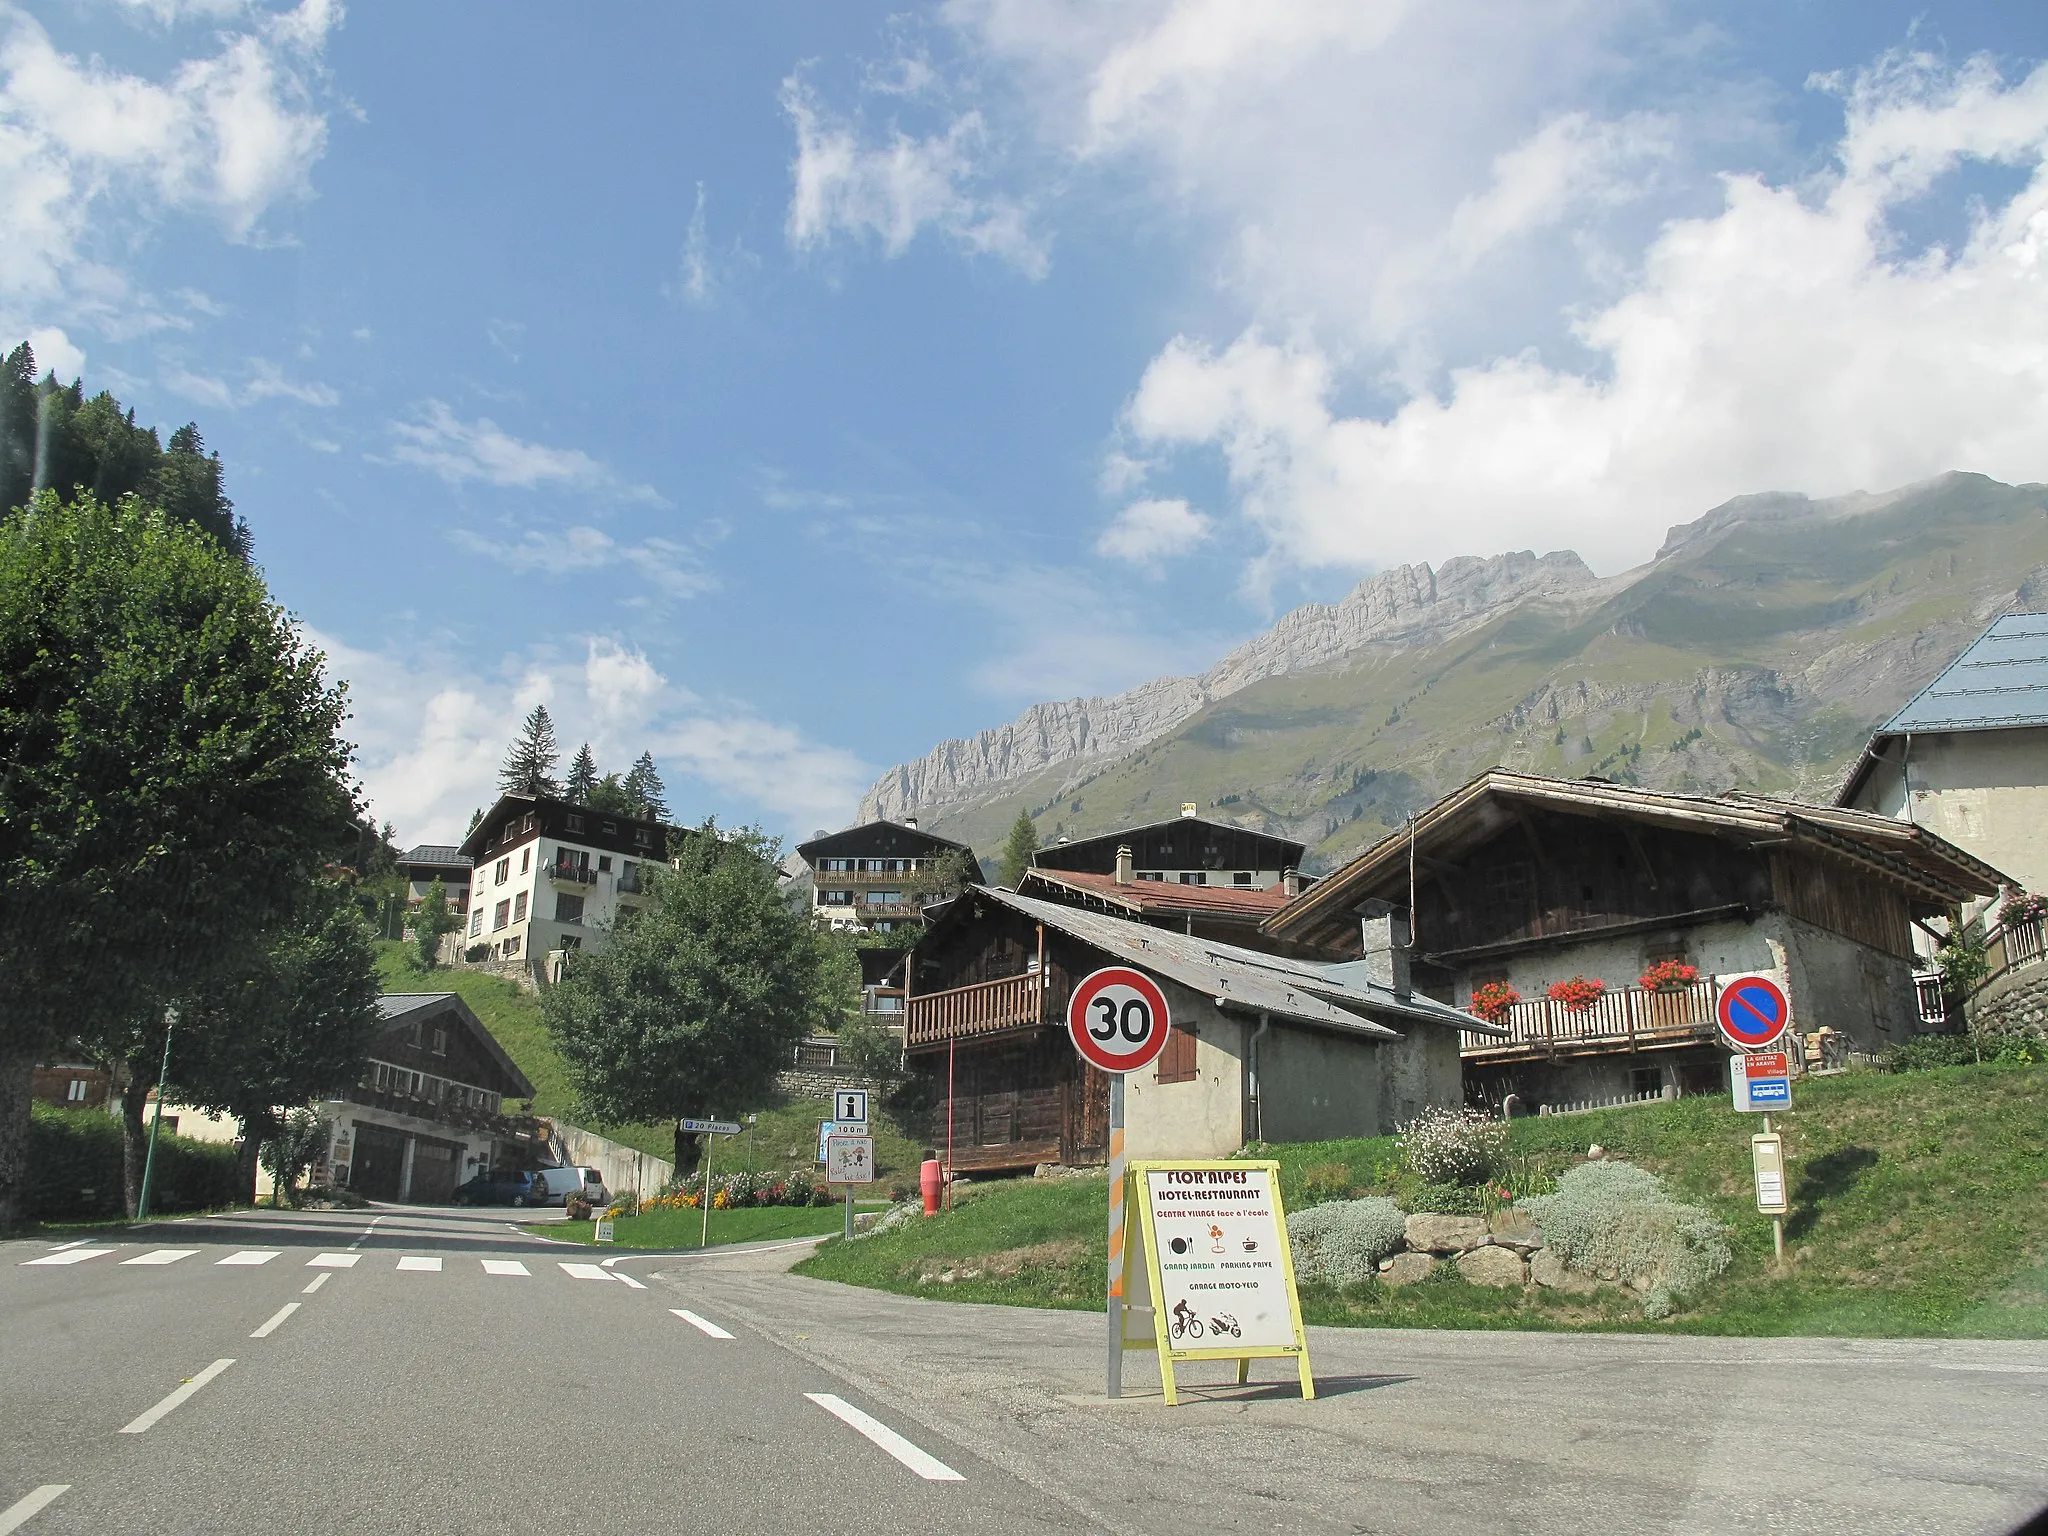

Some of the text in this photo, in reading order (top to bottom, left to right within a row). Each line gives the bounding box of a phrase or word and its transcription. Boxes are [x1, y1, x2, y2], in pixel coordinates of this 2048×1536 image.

[1089, 996, 1150, 1043] 30
[707, 1123, 730, 1132] Places
[1167, 1171, 1247, 1184] FLOR'ALPES
[1158, 1189, 1260, 1200] HOTEL-RESTAURANT
[1157, 1210, 1186, 1218] CENTRE
[1164, 1262, 1215, 1271] GRAND JARDIN
[1218, 1281, 1259, 1290] MOTO-VELO
